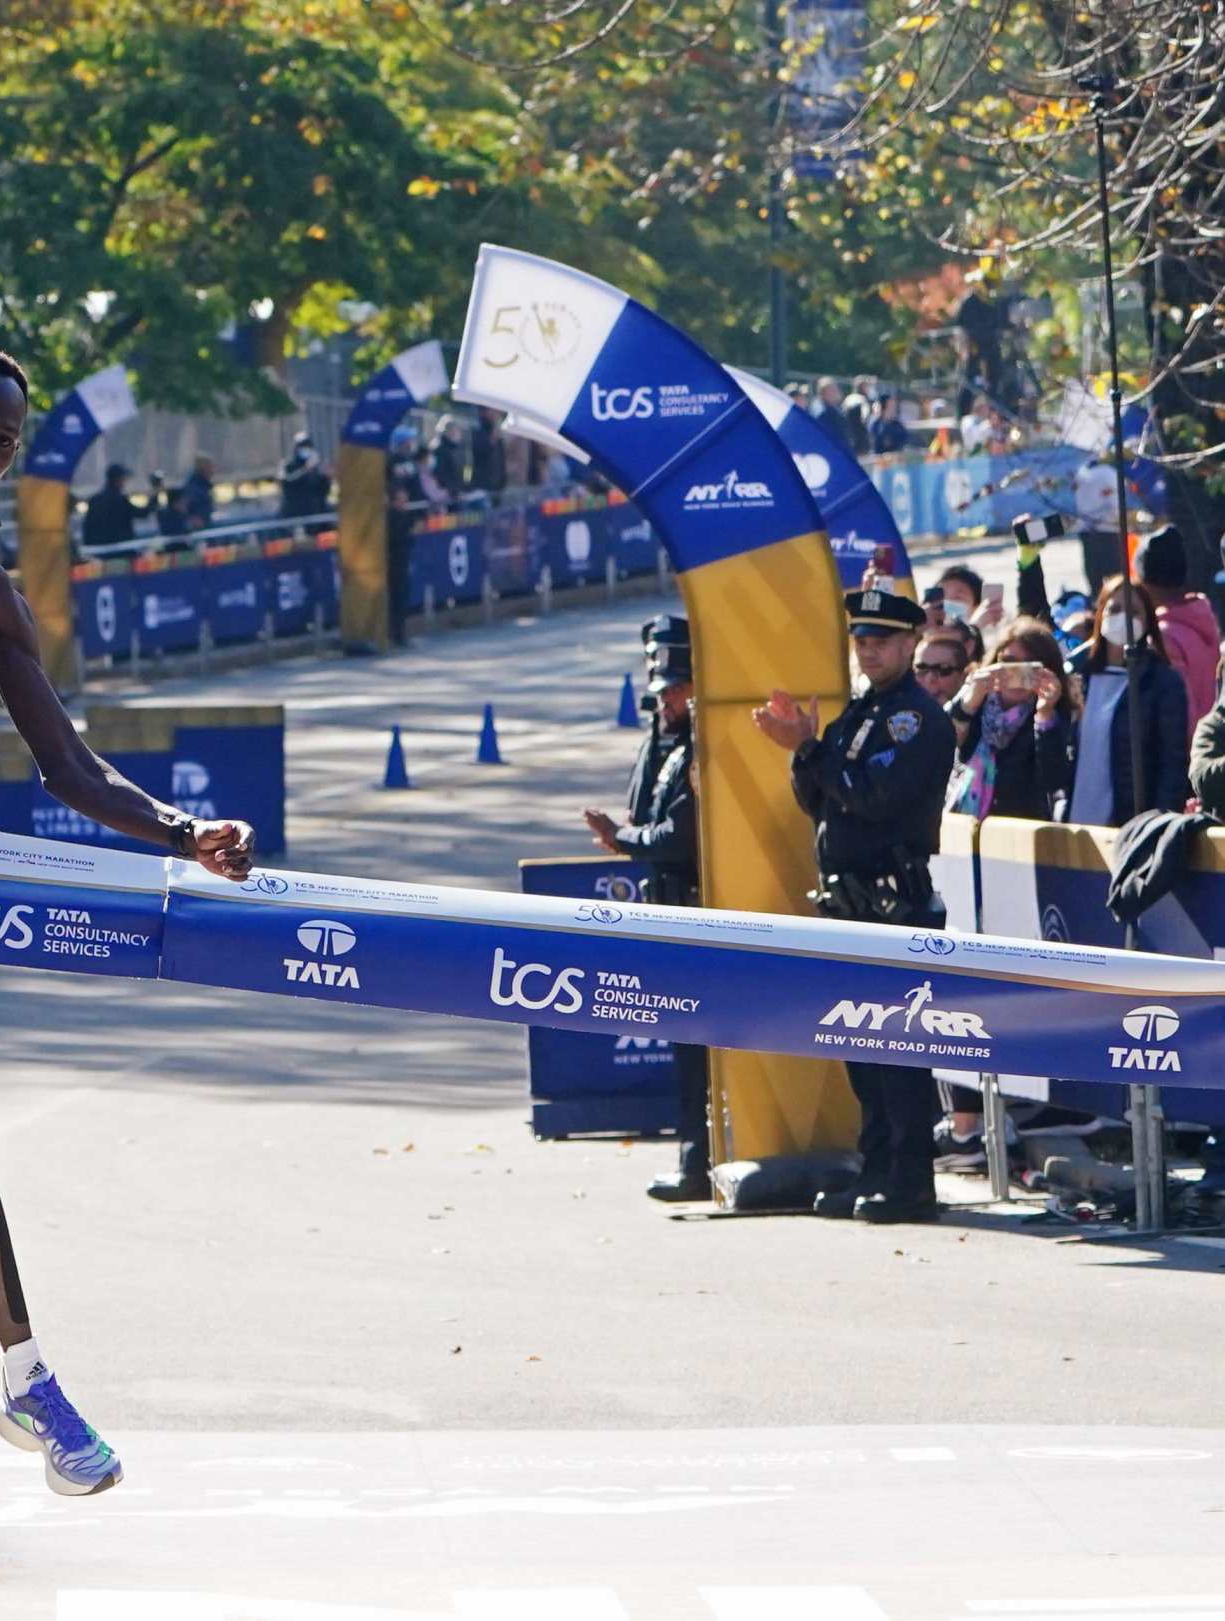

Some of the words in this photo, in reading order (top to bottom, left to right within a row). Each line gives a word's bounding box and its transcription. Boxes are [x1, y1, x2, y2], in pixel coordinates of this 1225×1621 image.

[590, 382, 655, 421] tcs
[658, 384, 689, 397] TATA
[22, 851, 44, 861] CITY
[44, 854, 96, 867] MARATHON
[294, 881, 316, 889] TCS
[46, 907, 91, 925] TATA
[628, 910, 650, 918] TCS
[44, 923, 150, 947] CONSULTANCY
[42, 939, 111, 958] SERVICES
[283, 958, 361, 990] TATA
[489, 946, 585, 1014] tcs
[596, 971, 641, 990] TATA
[593, 988, 701, 1013] CONSULTANCY
[591, 1004, 659, 1024] SERVICES
[818, 1000, 993, 1039] NYRR
[814, 1033, 846, 1046] NEW
[850, 1037, 885, 1050] YORK
[888, 1040, 925, 1053] ROAD
[929, 1044, 991, 1059] RUNNERS
[1107, 1046, 1182, 1073] TATA
